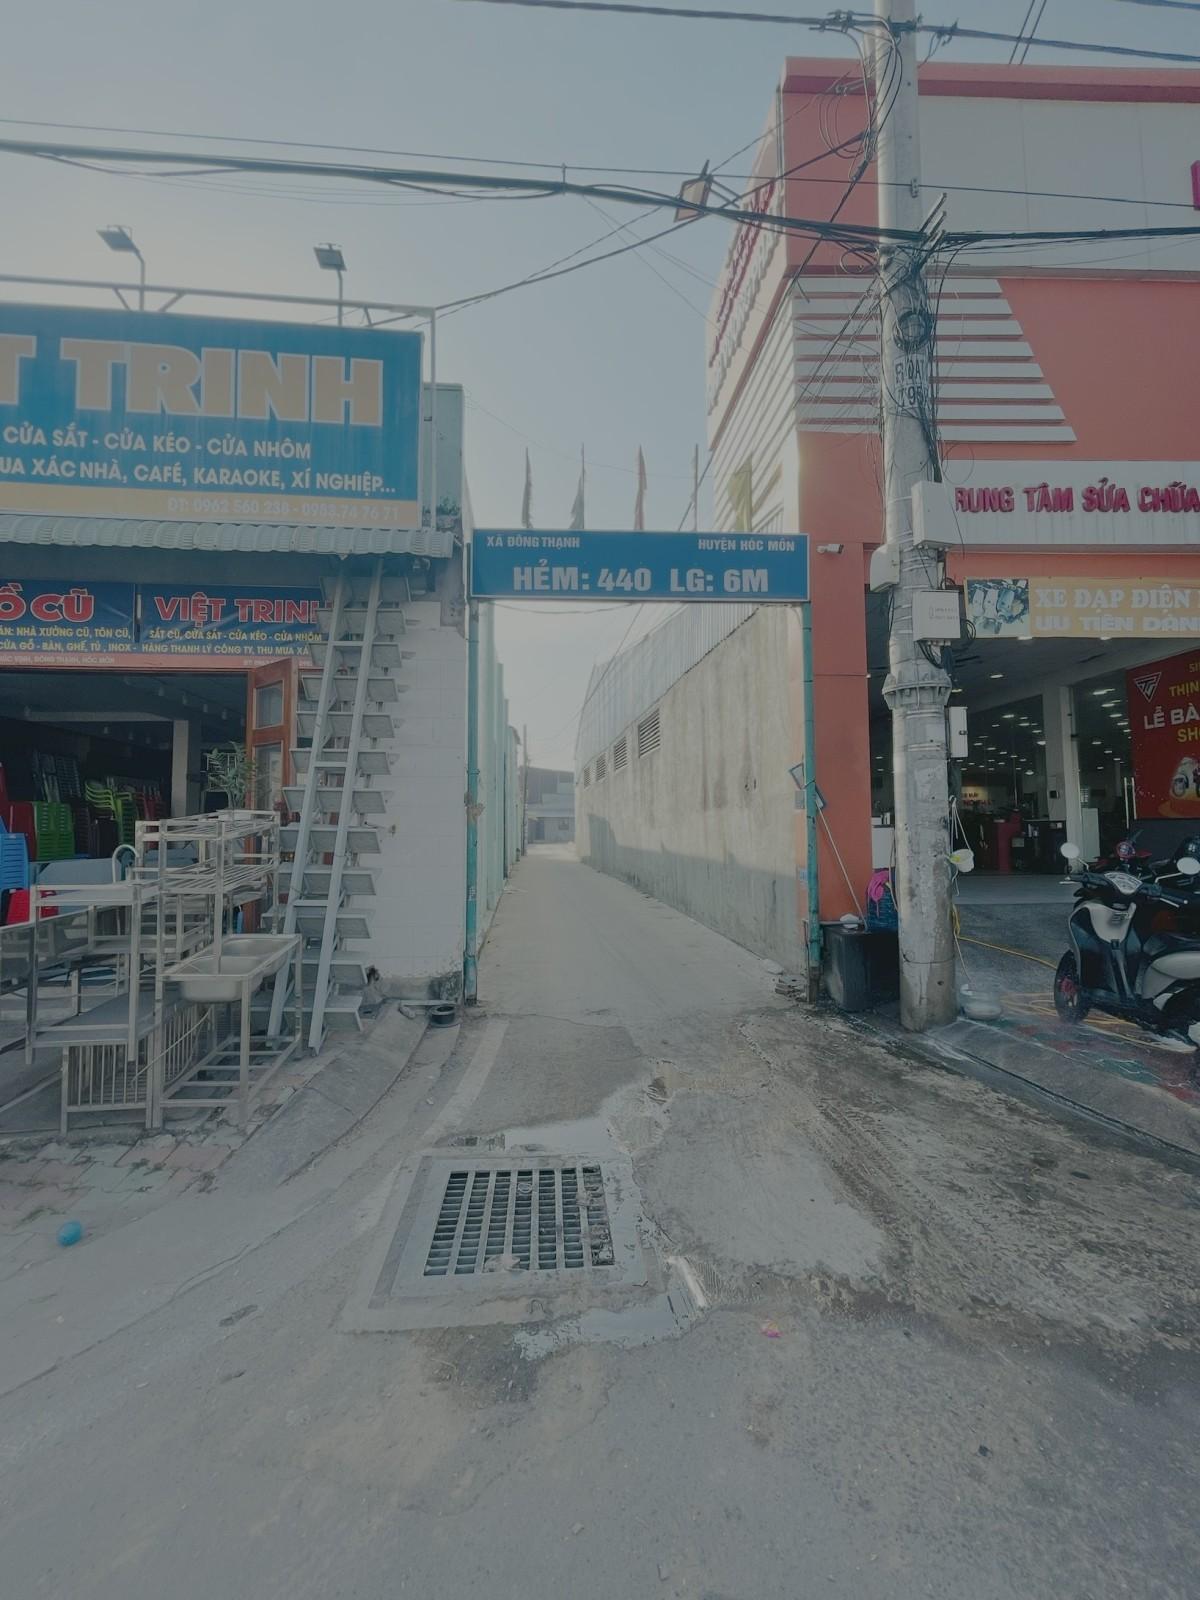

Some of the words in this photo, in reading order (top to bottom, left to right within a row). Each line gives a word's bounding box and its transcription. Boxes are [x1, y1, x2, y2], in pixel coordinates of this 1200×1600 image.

[60, 337, 384, 426] TRINH
[3, 420, 47, 446] CỬA
[52, 421, 88, 448] SẮT
[104, 427, 147, 450] CỬA
[153, 432, 191, 453] KÉO
[207, 433, 248, 456] CỬA
[254, 438, 311, 459] NHÔM
[31, 455, 76, 478] XÁC
[80, 458, 128, 483] NHÀ,
[133, 462, 187, 486] CAFÉ,
[194, 466, 286, 490] KARAOKE,
[291, 468, 310, 489] XÍ
[316, 471, 396, 496] NGHIỆP...
[1023, 482, 1074, 513] TÂM
[1082, 477, 1131, 513] SỬA
[1138, 481, 1200, 513] CHỮA
[541, 536, 580, 550] THẠNH
[698, 537, 736, 552] HUYỆN
[740, 538, 764, 551] HÓC
[768, 538, 795, 551] MÔN
[513, 558, 591, 591] HẺM:
[597, 568, 652, 591] 440
[670, 568, 714, 592] LG:
[723, 568, 769, 592] 6M
[30, 588, 94, 622] CŨ
[154, 591, 226, 628] VIỆT
[1035, 588, 1067, 608] XE
[1073, 588, 1124, 613] ĐẠP
[1131, 584, 1190, 613] ĐIỆN
[17, 625, 36, 637] NHÀ
[170, 643, 200, 654] THANH
[1144, 706, 1165, 730] LỄ
[1177, 727, 1200, 743] SH
